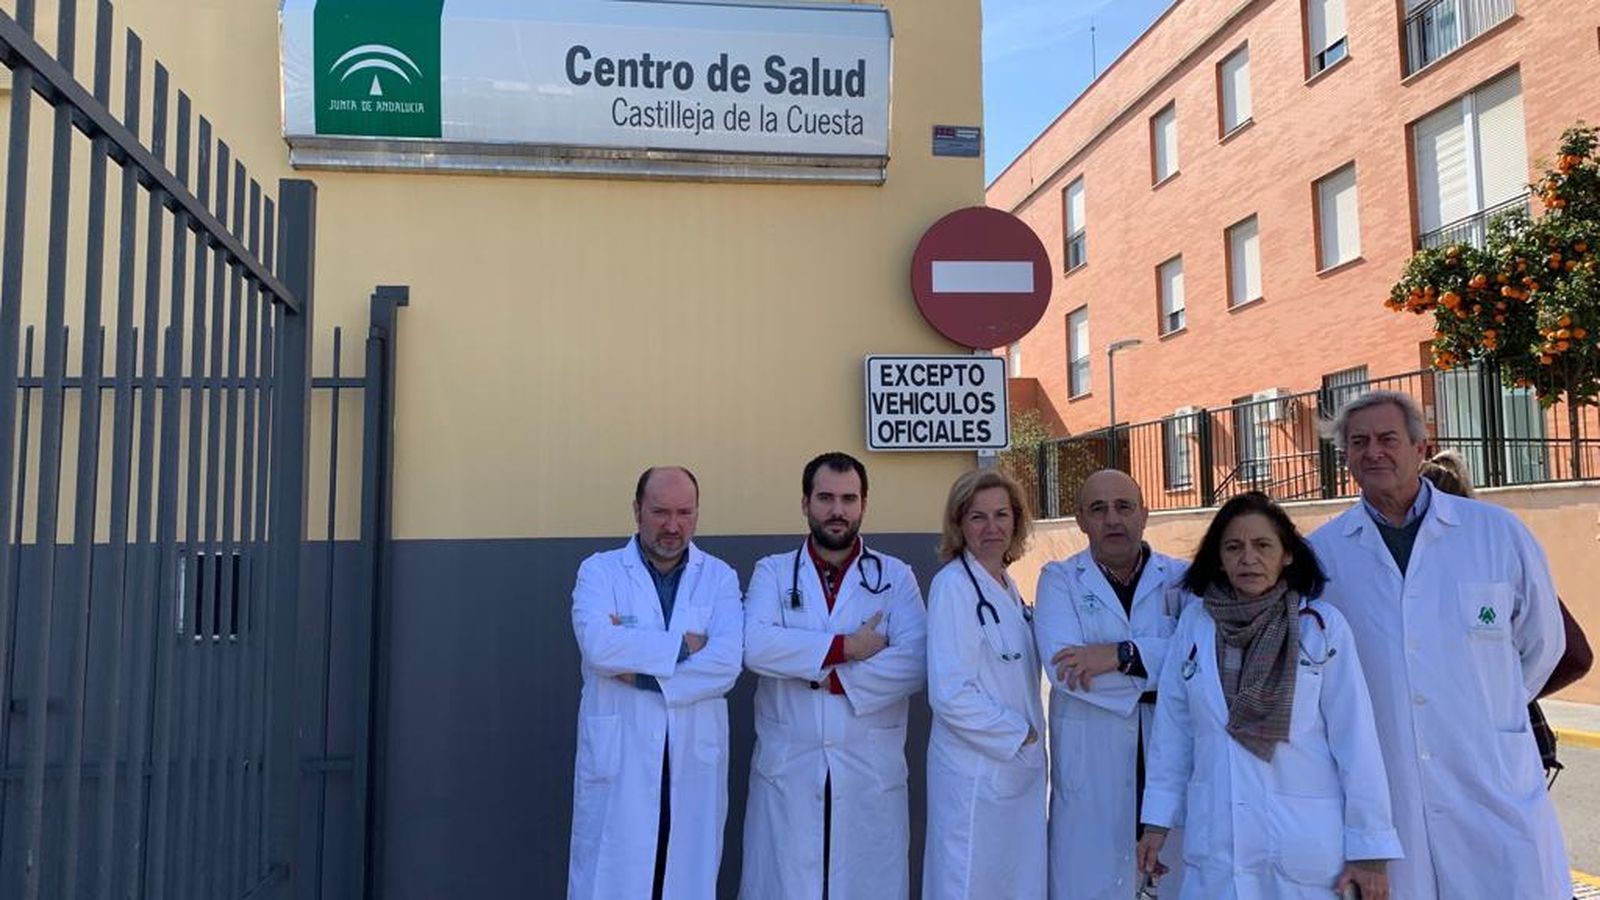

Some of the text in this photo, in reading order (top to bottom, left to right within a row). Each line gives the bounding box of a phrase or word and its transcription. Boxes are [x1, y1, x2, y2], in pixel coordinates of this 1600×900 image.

[565, 45, 866, 98] Centro de Salud
[329, 100, 425, 113] JUNTA DE ANDALUCIA
[611, 97, 864, 135] Castilleja de la Cuesta
[881, 364, 985, 386] EXCEPTO
[872, 391, 996, 415] VEHICULOS
[878, 420, 992, 443] OFICIALES
